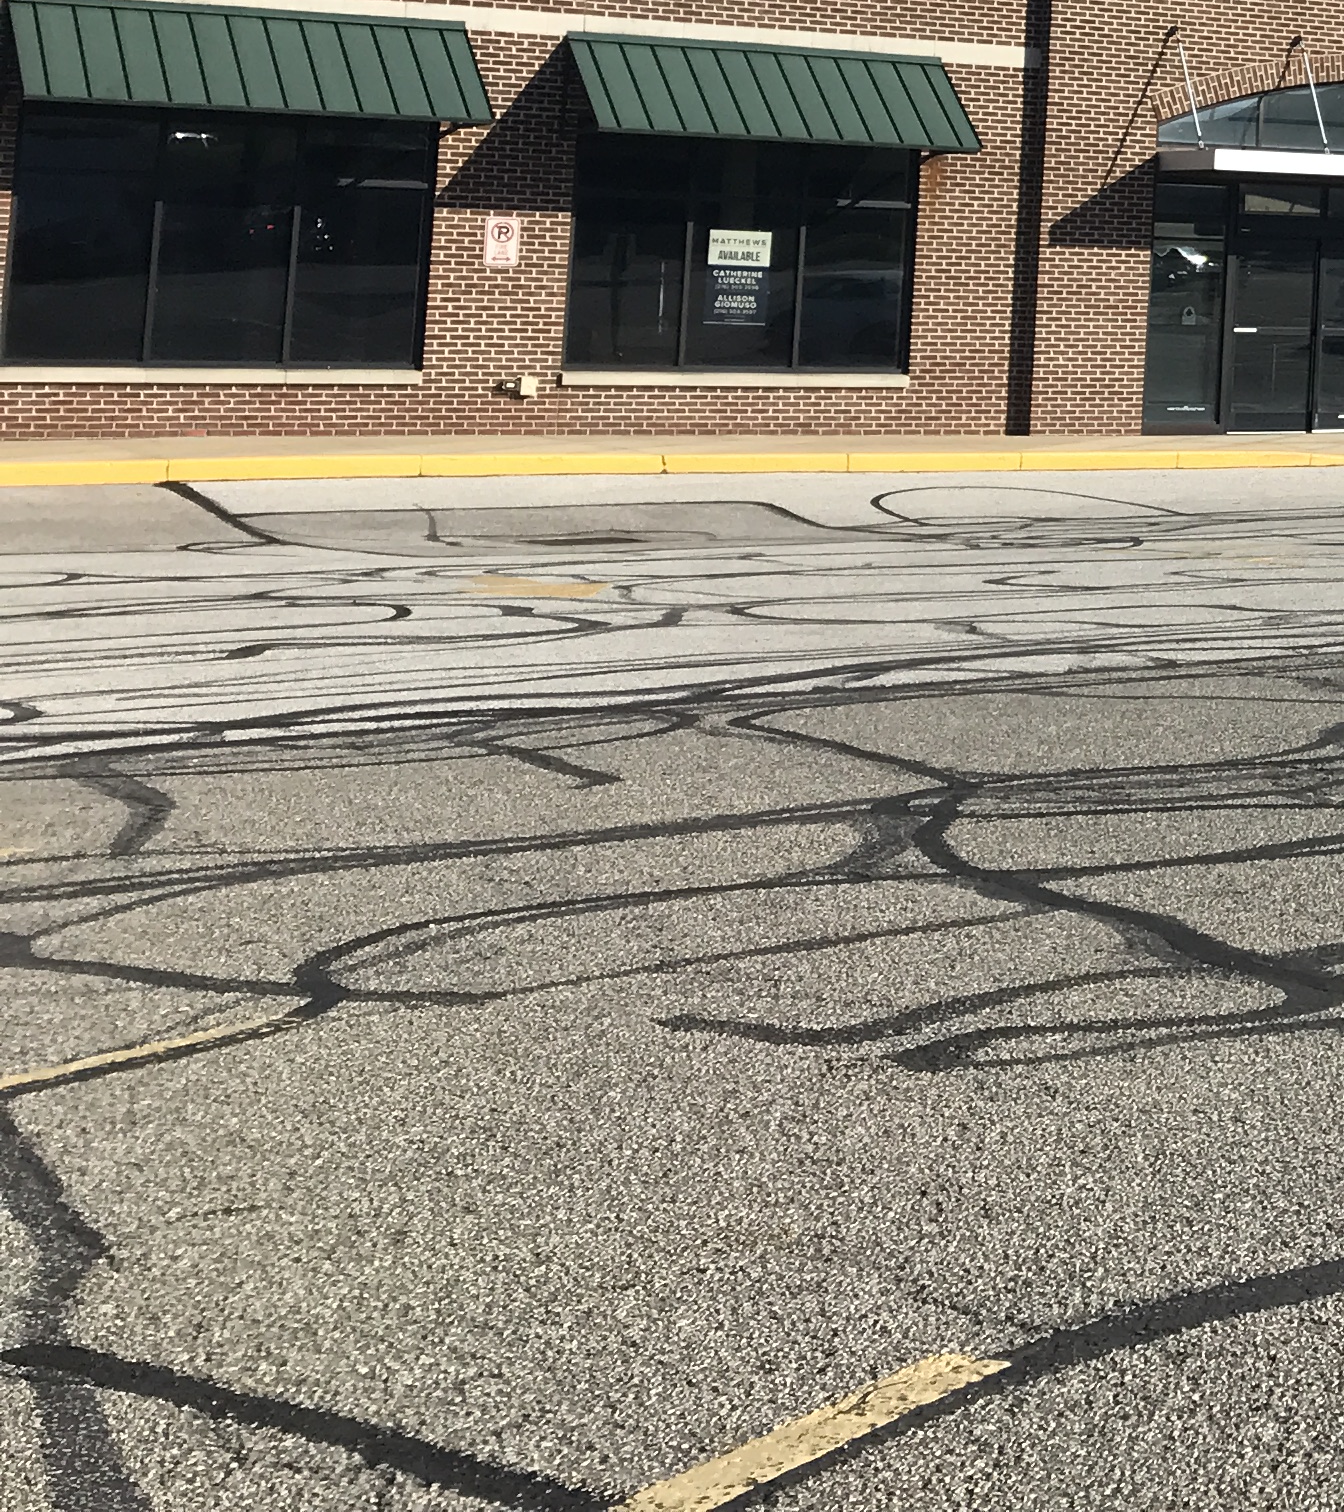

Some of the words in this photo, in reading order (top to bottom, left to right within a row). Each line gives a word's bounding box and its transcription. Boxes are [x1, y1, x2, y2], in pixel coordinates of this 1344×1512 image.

[711, 237, 767, 246] MATTHEWS
[717, 250, 761, 262] AVAILABLE
[712, 269, 763, 278] CATHERINE
[717, 277, 757, 285] LUECKEL
[717, 294, 755, 302] ALLISON
